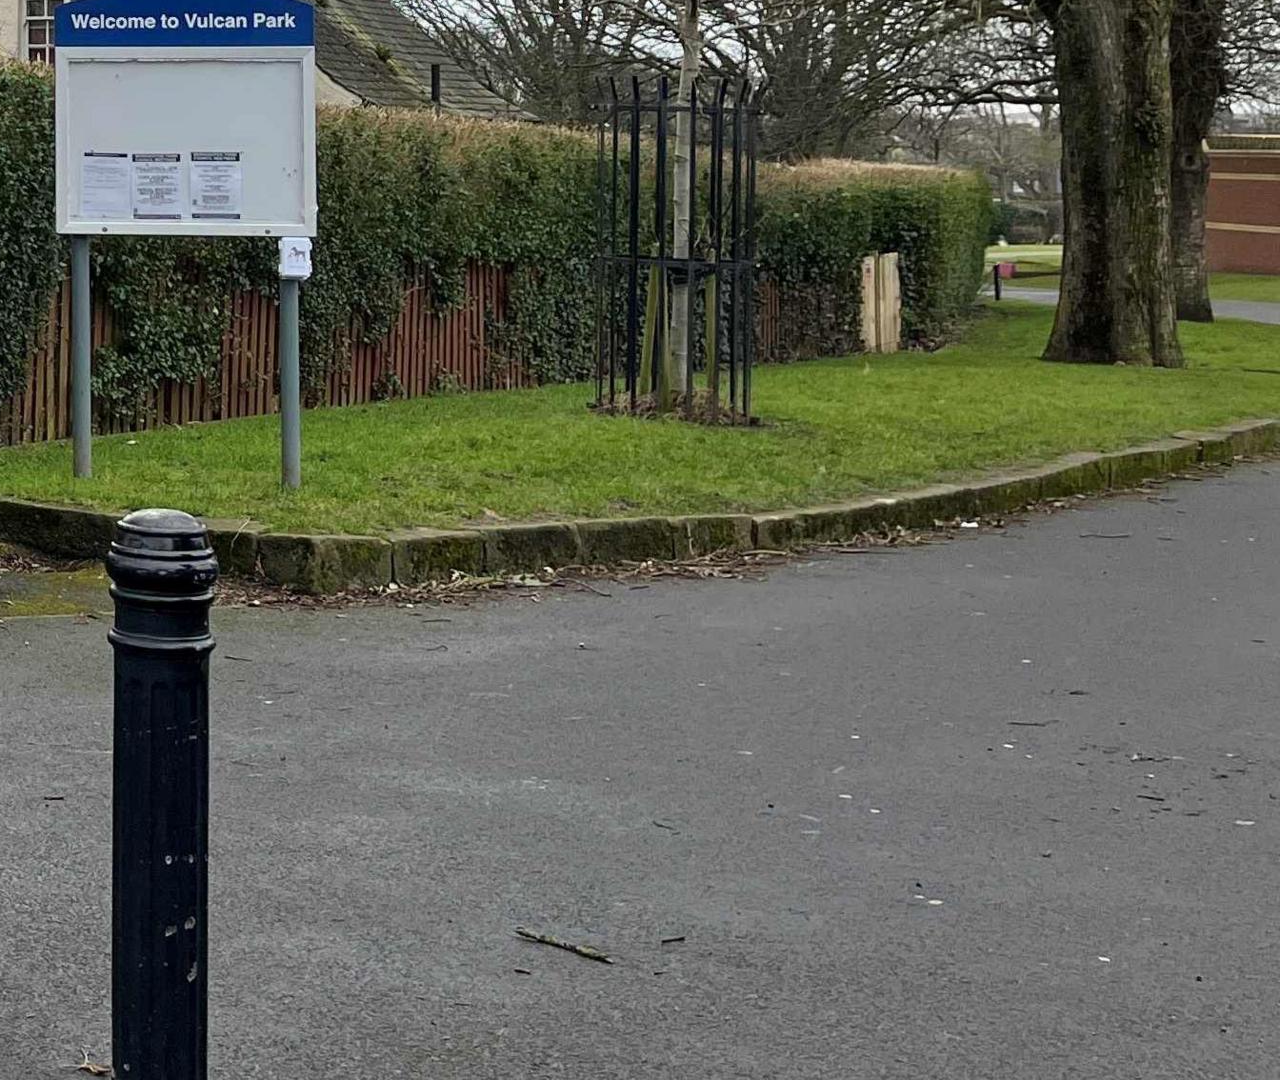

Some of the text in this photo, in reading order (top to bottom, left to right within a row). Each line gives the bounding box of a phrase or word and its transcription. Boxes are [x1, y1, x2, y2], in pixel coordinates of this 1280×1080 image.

[71, 12, 296, 29] Welcome to Vulcan Park
